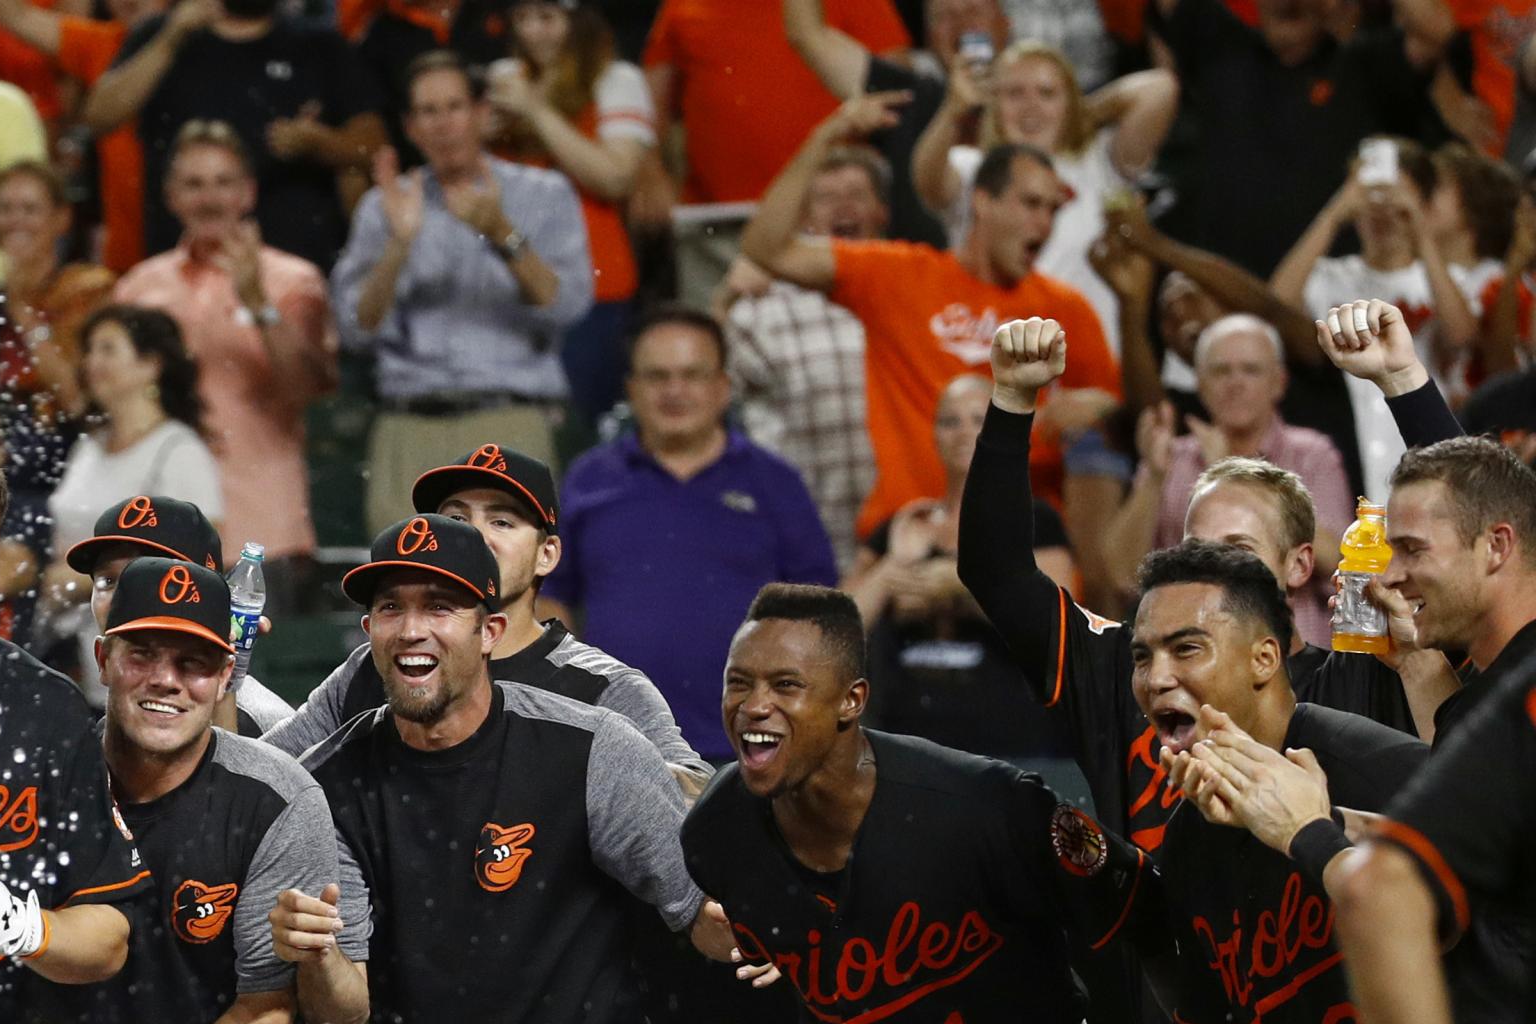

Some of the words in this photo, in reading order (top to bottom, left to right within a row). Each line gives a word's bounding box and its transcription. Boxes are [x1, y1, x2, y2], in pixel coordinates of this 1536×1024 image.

[118, 496, 158, 529] O's
[397, 517, 438, 556] O's
[159, 565, 200, 604] O's
